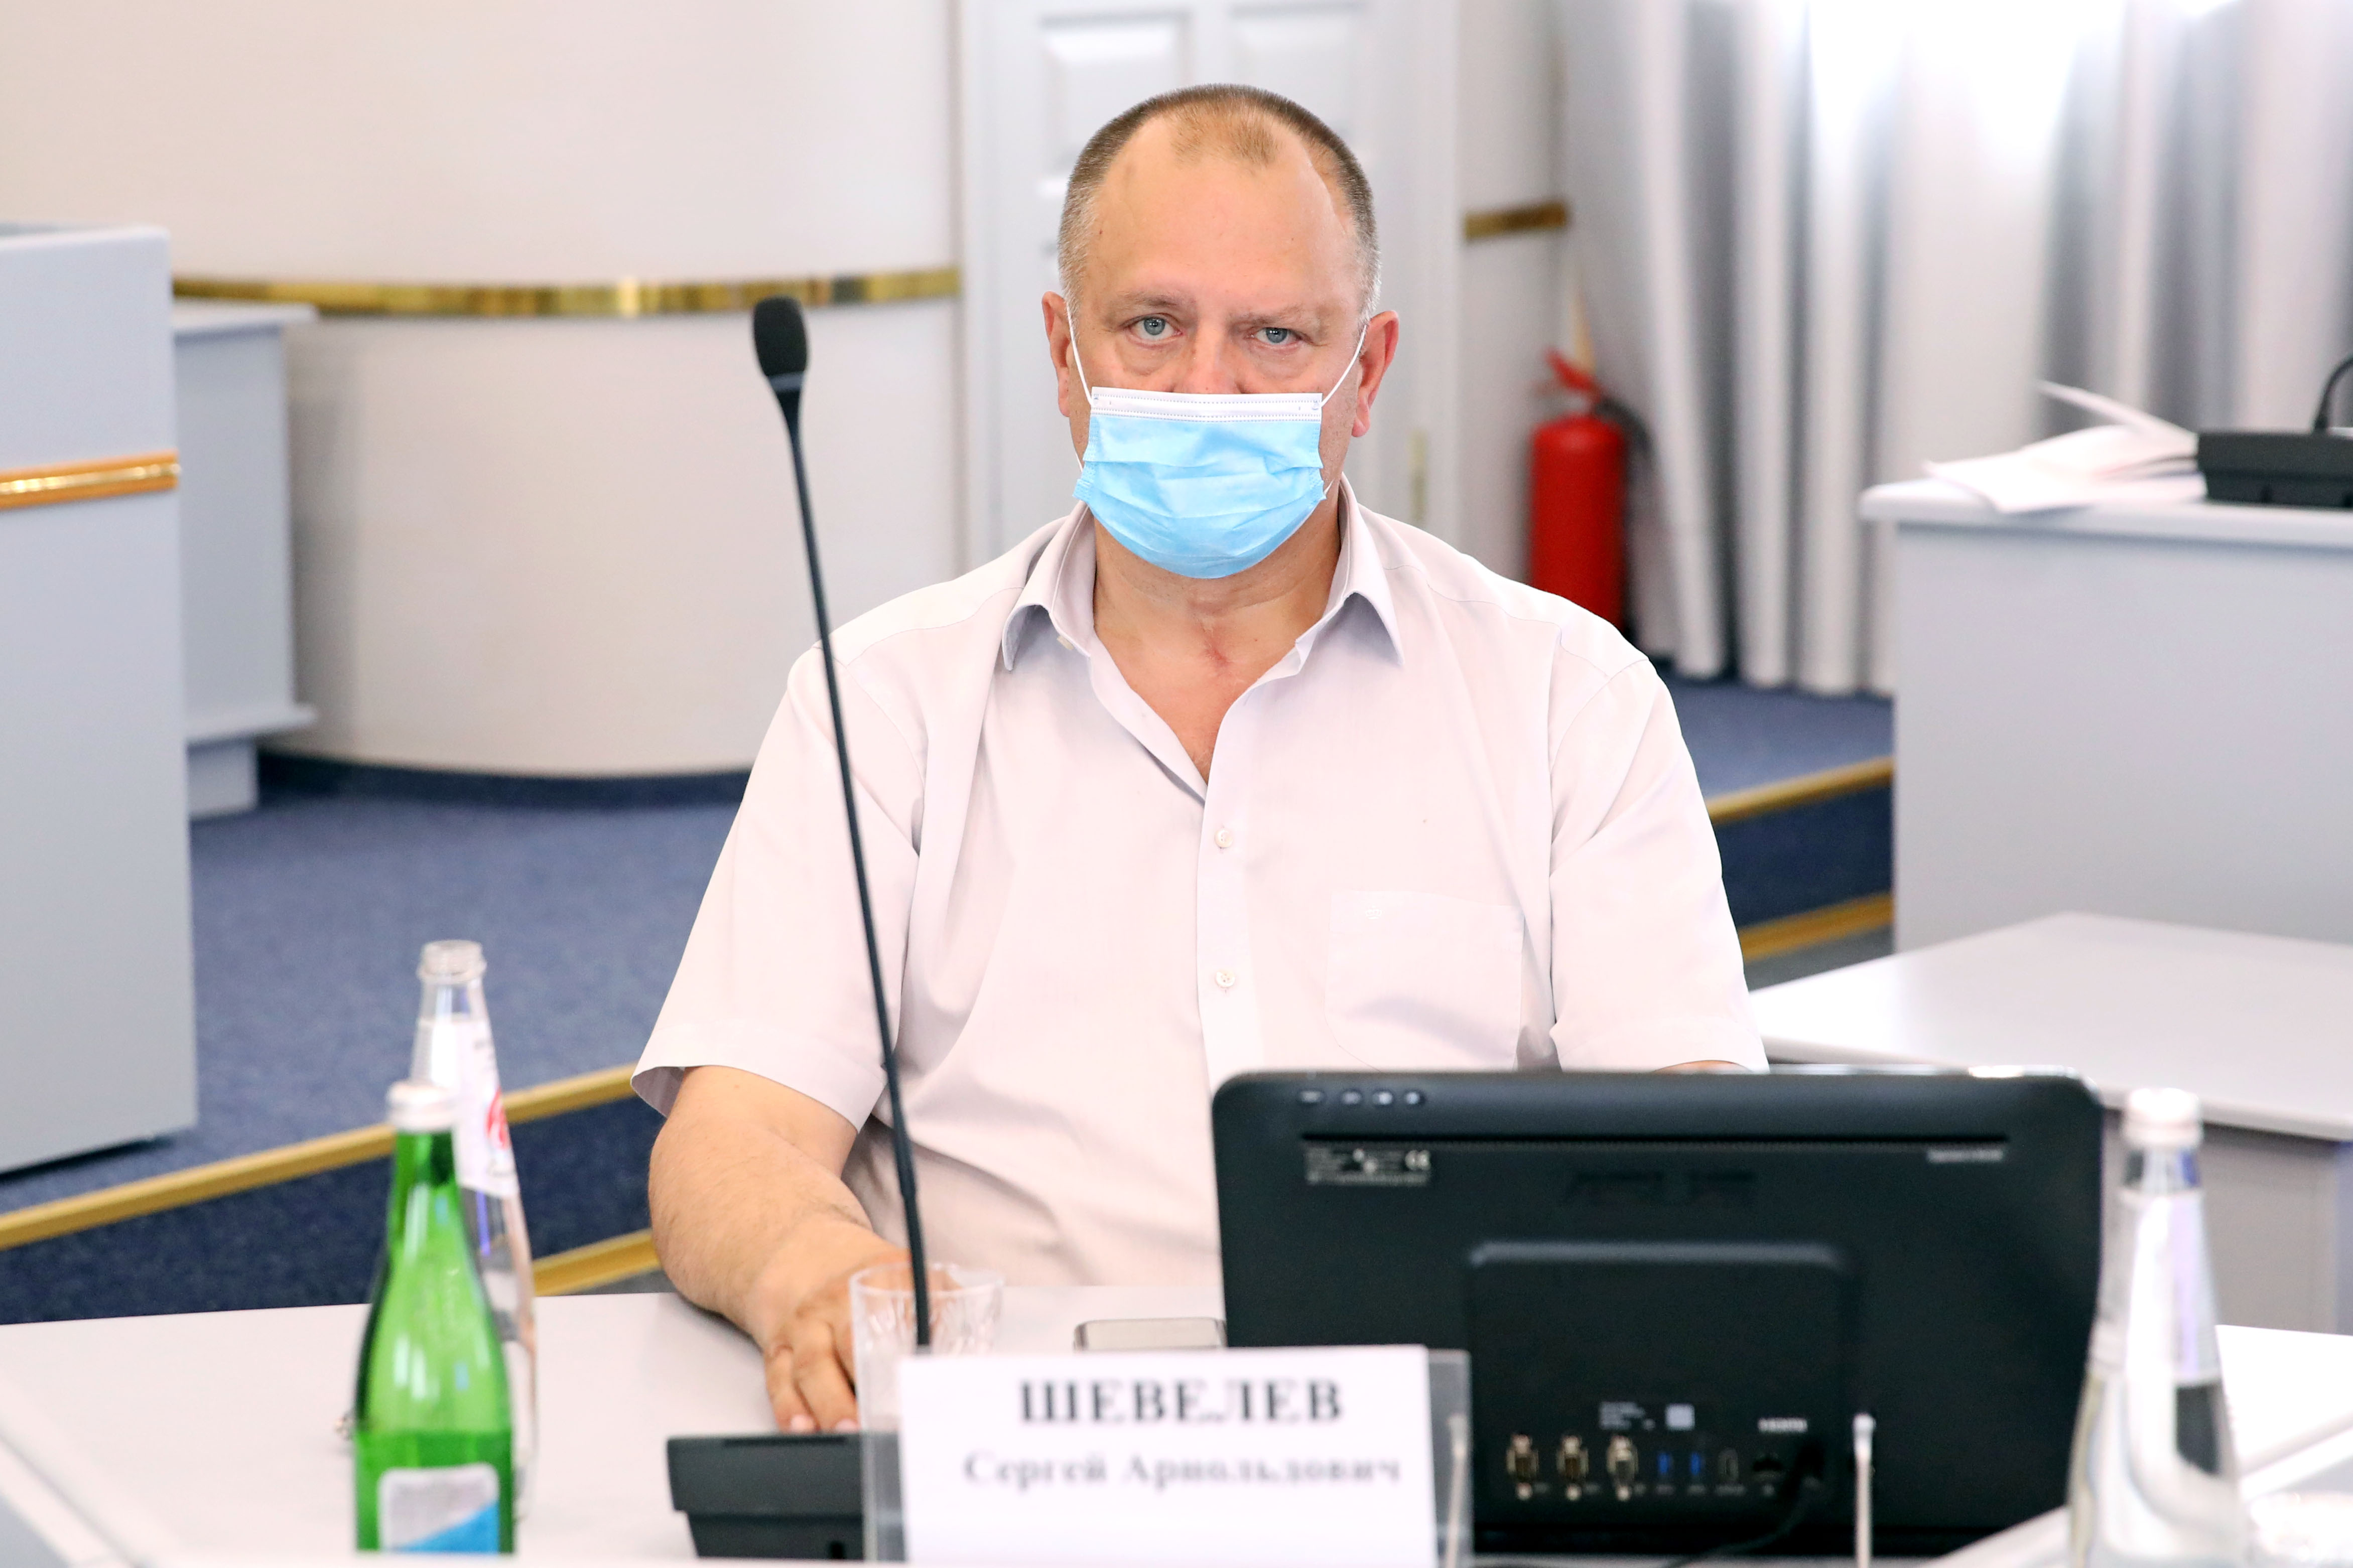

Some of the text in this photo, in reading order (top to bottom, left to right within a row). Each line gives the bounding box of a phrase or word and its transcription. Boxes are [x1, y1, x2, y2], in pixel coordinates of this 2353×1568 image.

[1019, 1379, 1342, 1424] ШЕВЕЛЕВ
[964, 1453, 1400, 1493] Сергей Арнольдович
